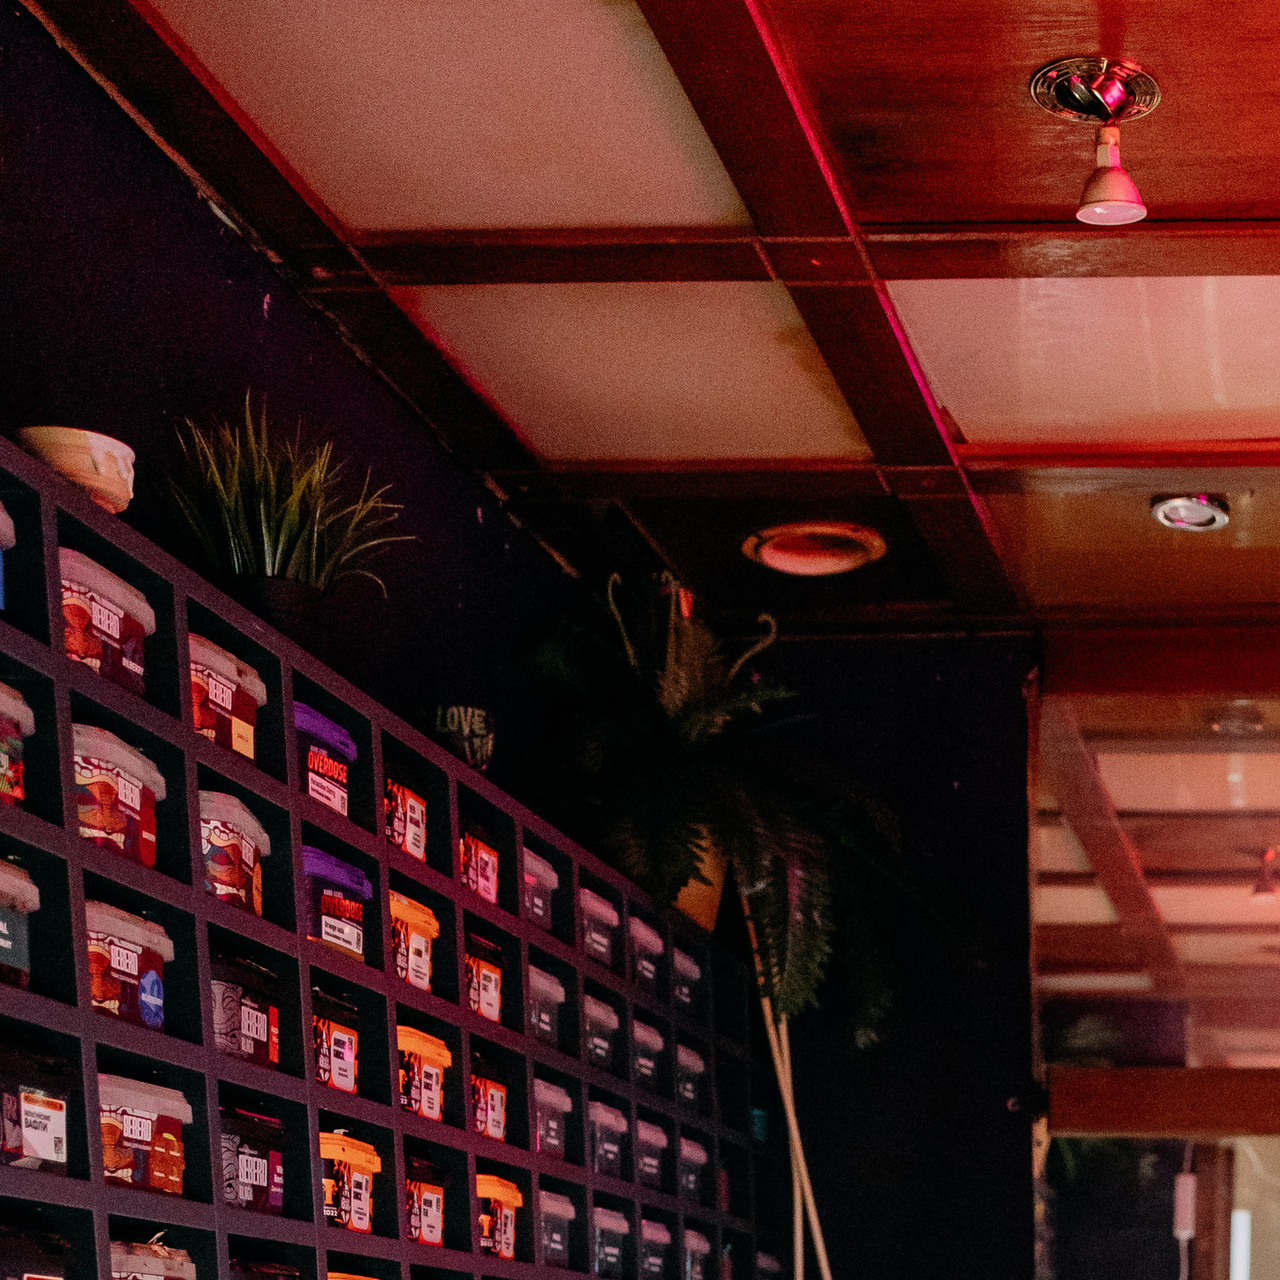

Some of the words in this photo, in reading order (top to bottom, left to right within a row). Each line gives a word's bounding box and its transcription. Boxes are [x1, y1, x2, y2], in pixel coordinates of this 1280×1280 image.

[308, 750, 348, 784] OVERDOSE
[321, 895, 363, 922] OVERDOSE
[238, 1154, 268, 1187] SEBERO
